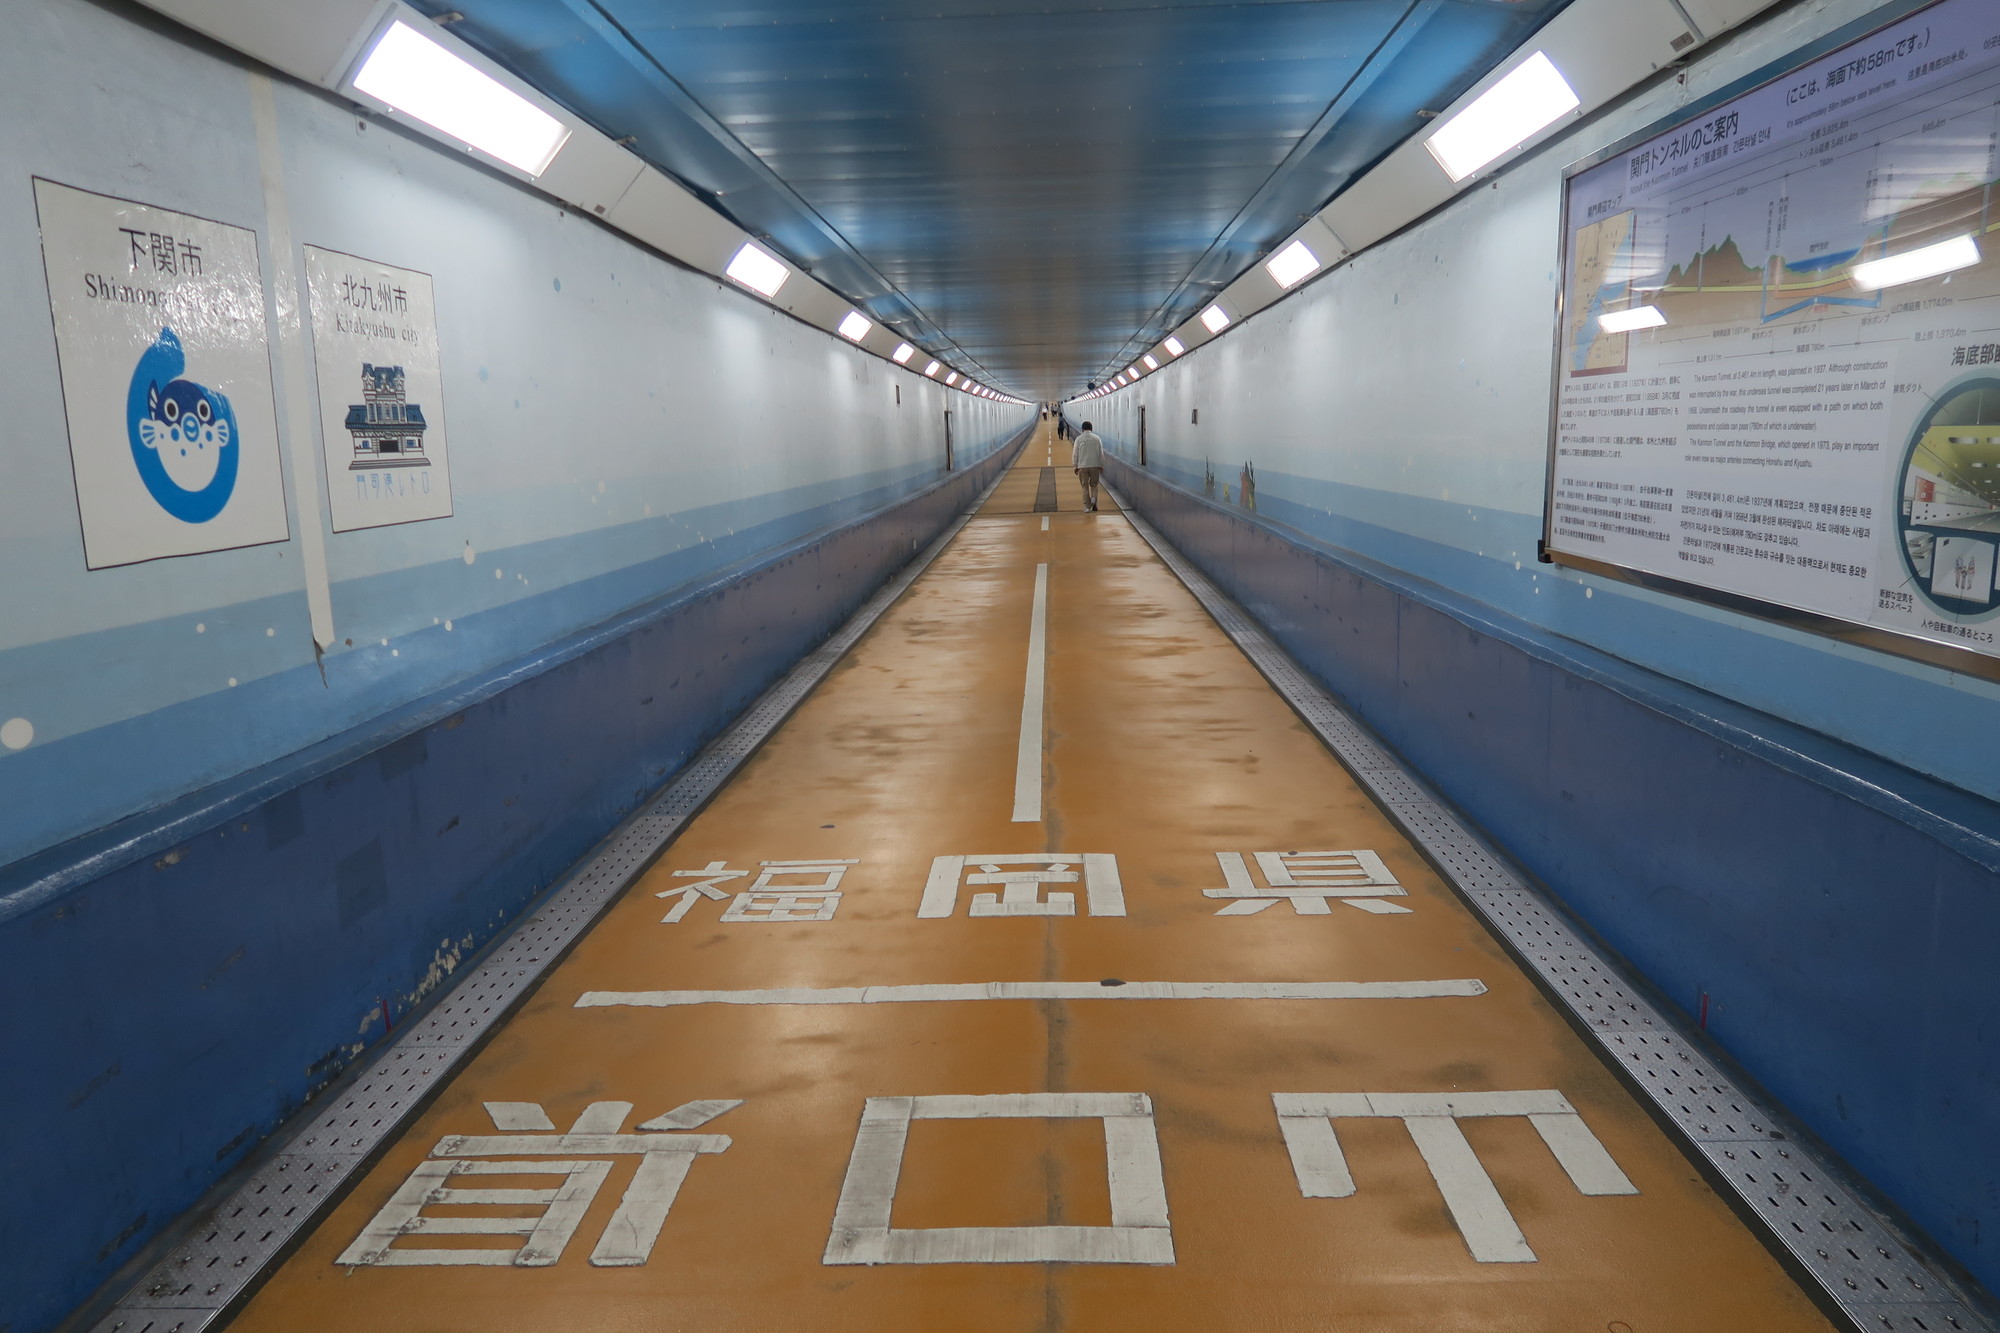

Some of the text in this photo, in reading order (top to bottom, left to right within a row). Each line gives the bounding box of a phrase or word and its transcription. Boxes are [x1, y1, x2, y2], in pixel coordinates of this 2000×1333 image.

[1630, 110, 1739, 180] 関門トンネルのご案内
[1671, 163, 1689, 177] Tunnel
[118, 227, 202, 278] 下関市
[342, 274, 408, 317] 北九州市
[336, 313, 419, 347] Kitakyushu city
[1702, 374, 1717, 382] Kanmon
[1787, 366, 1807, 377] planned
[1814, 364, 1827, 374] 1937.
[1828, 362, 1852, 374] Although
[1853, 360, 1888, 371] construction
[1738, 388, 1746, 396] this
[1747, 387, 1767, 396] undersea
[1767, 386, 1781, 395] tunnel
[1792, 384, 1817, 394] completed
[1825, 384, 1840, 393] years
[1841, 382, 1853, 391] later
[1860, 380, 1878, 390] March
[1893, 383, 1922, 394] 排気ダクト
[1729, 405, 1747, 415] roadway
[1756, 404, 1769, 413] tunnel
[1776, 405, 1787, 413] even
[1788, 403, 1811, 414] equipped
[1812, 402, 1823, 411] with
[1829, 402, 1841, 413] path
[1852, 401, 1868, 411] which
[1870, 401, 1883, 411] both
[1738, 423, 1749, 431] pass
[1749, 422, 1763, 431] (780m
[1769, 422, 1782, 430] which
[1697, 438, 1713, 447] Kanmon
[1713, 438, 1727, 447] Tunnel
[1743, 439, 1760, 448] Kanmon
[1777, 440, 1791, 449] which
[1792, 441, 1810, 450] opened
[1817, 440, 1830, 451] 1973,
[1831, 441, 1843, 452] play
[1852, 442, 1879, 453] important
[1715, 456, 1726, 465] major
[1727, 456, 1742, 464] arteries
[1742, 457, 1765, 467] connecting
[1766, 457, 1783, 466] Honshu
[1794, 458, 1813, 469] Kyushu.
[356, 471, 430, 502] 門司港レトロ
[1751, 497, 1773, 508] 1937년에
[1777, 517, 1814, 531] 해저터널입니다.
[1828, 524, 1851, 536] 아래에는
[1779, 535, 1800, 547] 있습니다.
[1736, 545, 1753, 557] 간몬교는
[1797, 556, 1829, 571] 대동맥으로서
[1880, 588, 1914, 604] 新鮮な空気を
[1878, 599, 1913, 614] 送るスペース
[1920, 619, 1994, 643] 人や自転車の通るところ
[654, 851, 1414, 923] 福岡県
